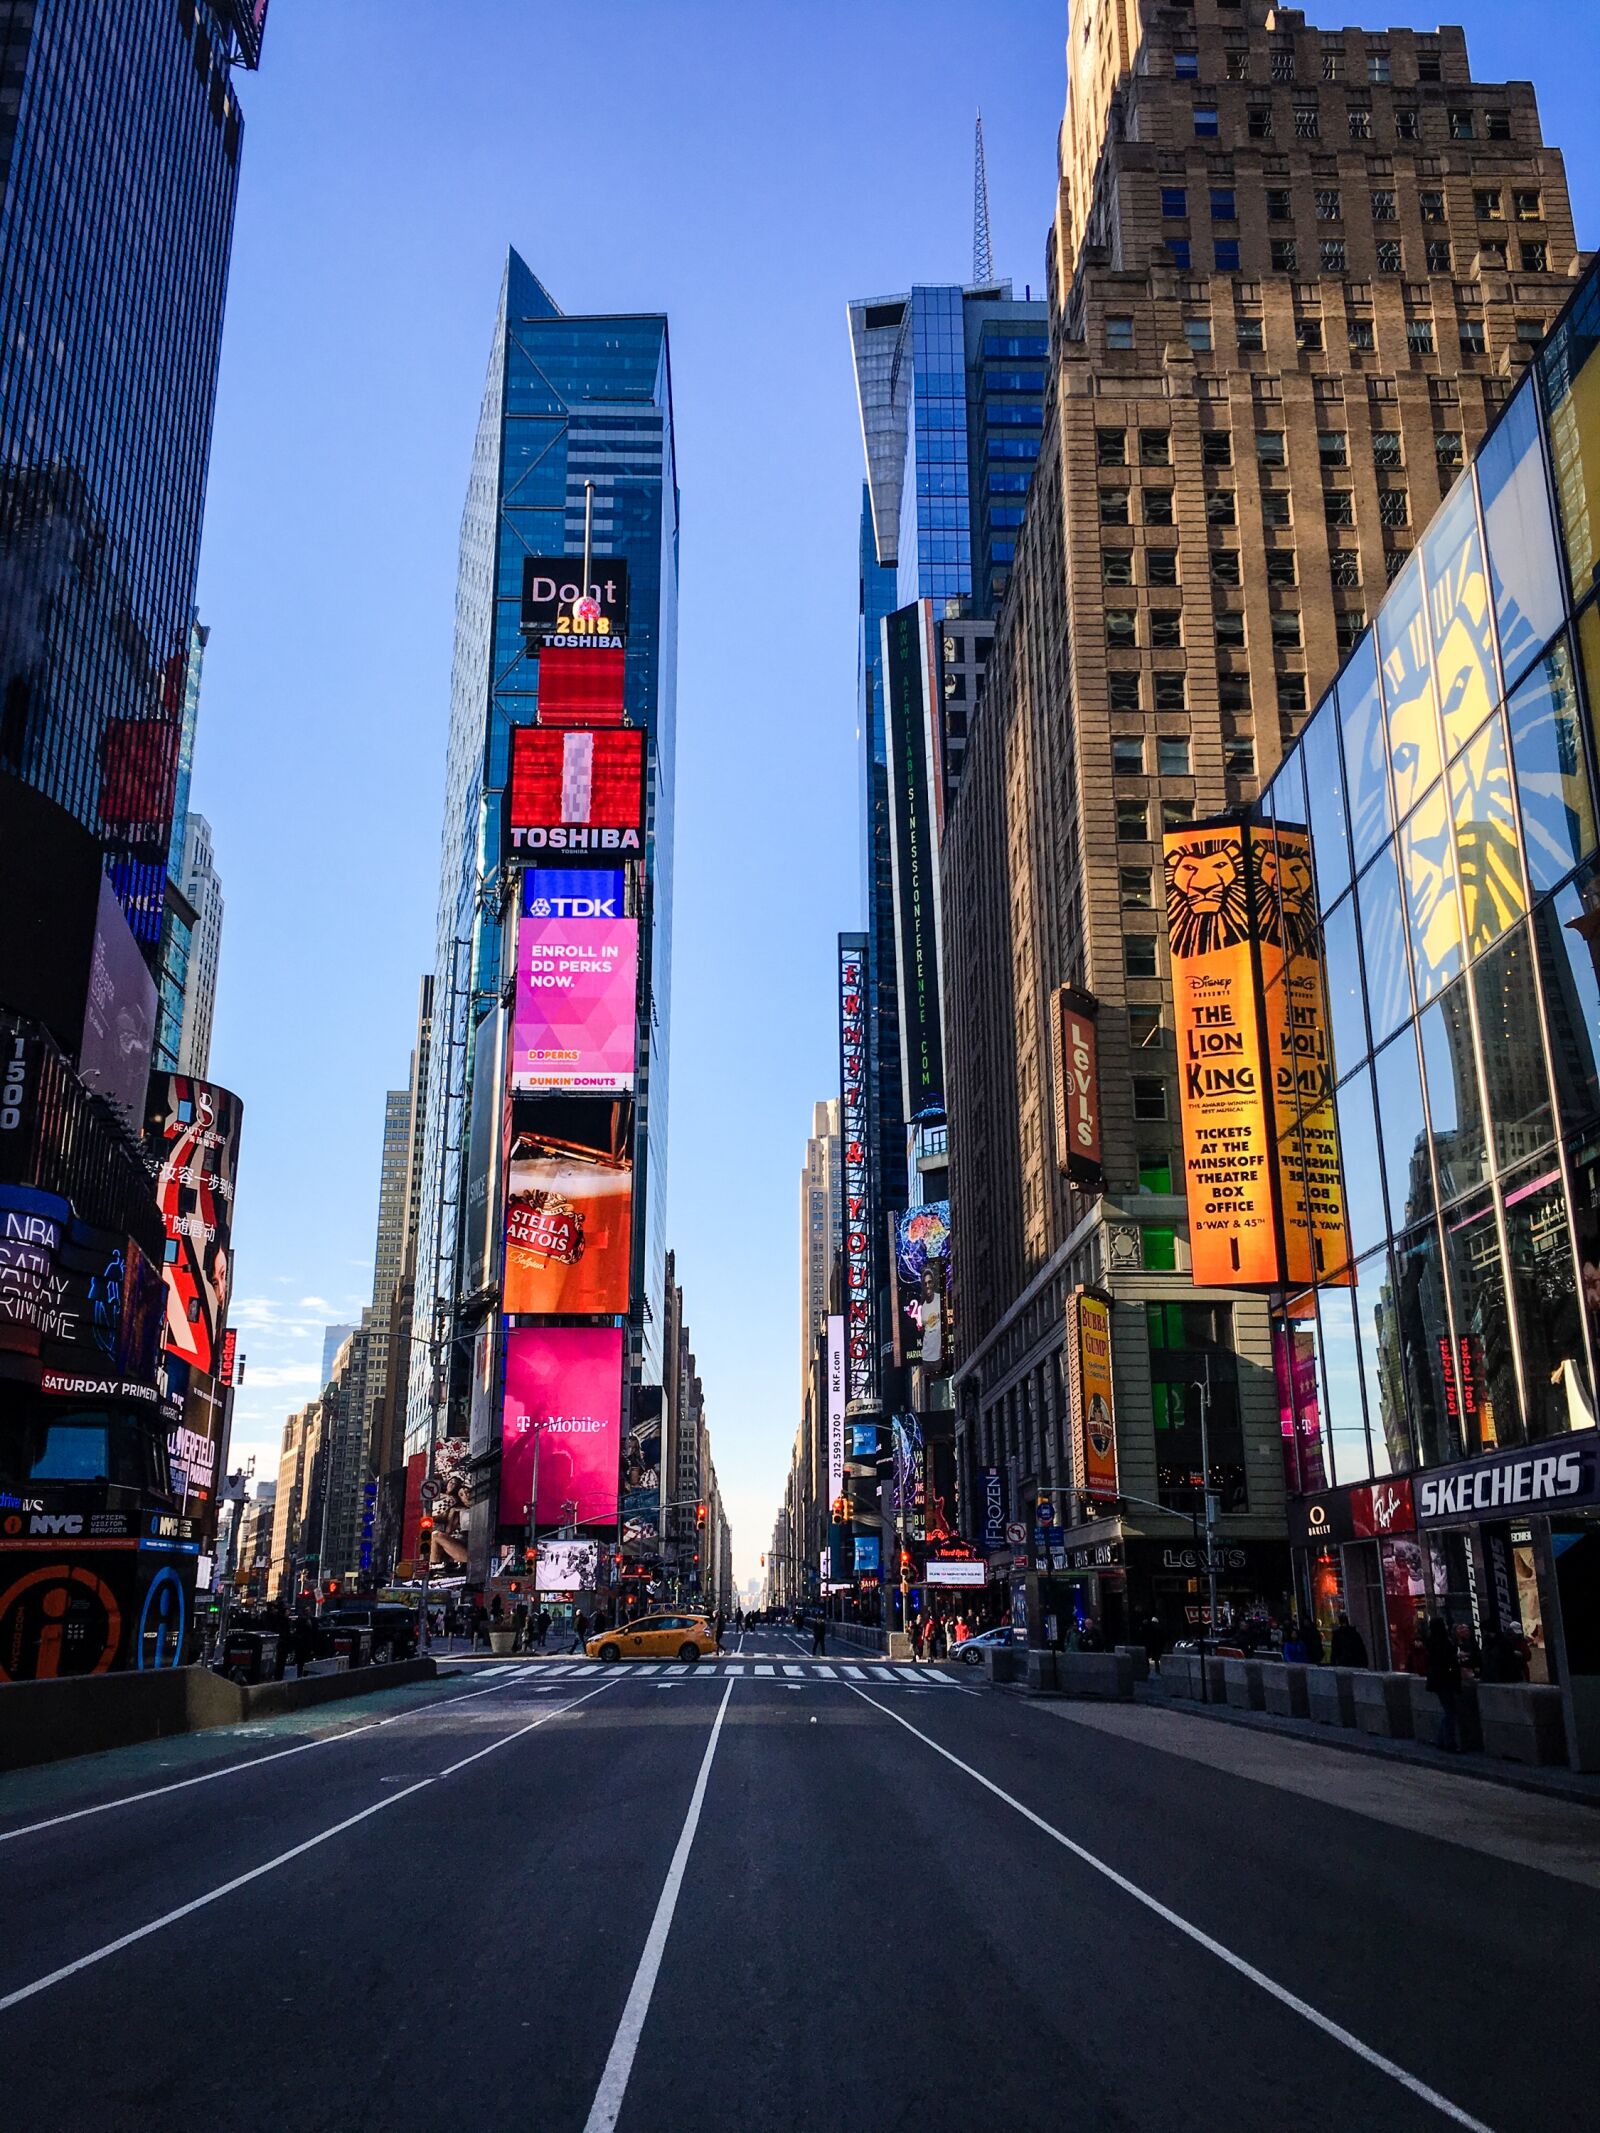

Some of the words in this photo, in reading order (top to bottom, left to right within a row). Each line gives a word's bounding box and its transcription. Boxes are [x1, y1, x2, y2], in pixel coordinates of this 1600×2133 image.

[556, 617, 610, 635] 2018
[543, 635, 623, 648] TOSHIBA
[510, 828, 640, 849] TOSHIBA
[550, 898, 616, 917] TDK
[531, 945, 598, 958] ENROLL
[602, 946, 619, 957] IN
[531, 961, 554, 973] DD
[559, 961, 613, 973] PERKS
[530, 975, 575, 988] NOW.
[1185, 975, 1232, 989] Disney
[1191, 1004, 1232, 1024] THE
[844, 964, 861, 1107] ERNST
[0, 1038, 25, 1129] 1500
[529, 1077, 574, 1086] DUNKIN'
[574, 1077, 616, 1086] DONUTS
[173, 1122, 203, 1136] BEAUTY
[204, 1130, 226, 1145] SCENES
[1195, 1127, 1252, 1139] TICKETS
[845, 1141, 863, 1163] &
[1201, 1143, 1217, 1154] AT
[1223, 1142, 1249, 1152] THE
[1188, 1156, 1264, 1170] MINSKOFF
[1196, 1171, 1258, 1184] THEATRE
[1212, 1186, 1244, 1198] BOX
[1205, 1201, 1254, 1213] OFFICE
[6, 1212, 55, 1249] NBA
[511, 1210, 569, 1237] STELLA
[1196, 1220, 1230, 1230] B'WAY
[1233, 1220, 1240, 1228] &
[507, 1224, 568, 1251] ARTOIS
[848, 1198, 867, 1359] YOUNG
[1082, 1306, 1107, 1333] BUBBA
[219, 1332, 236, 1374] Locker
[1085, 1332, 1107, 1357] GUMP
[44, 1375, 118, 1394] SATURDAY
[833, 1413, 841, 1478] 212.599.3700
[1421, 1451, 1581, 1518] SKECHERS
[986, 1476, 1005, 1540] FROZEN
[30, 1515, 83, 1534] NYC
[159, 1516, 178, 1535] NYC
[1308, 1525, 1331, 1536] OAKLEY
